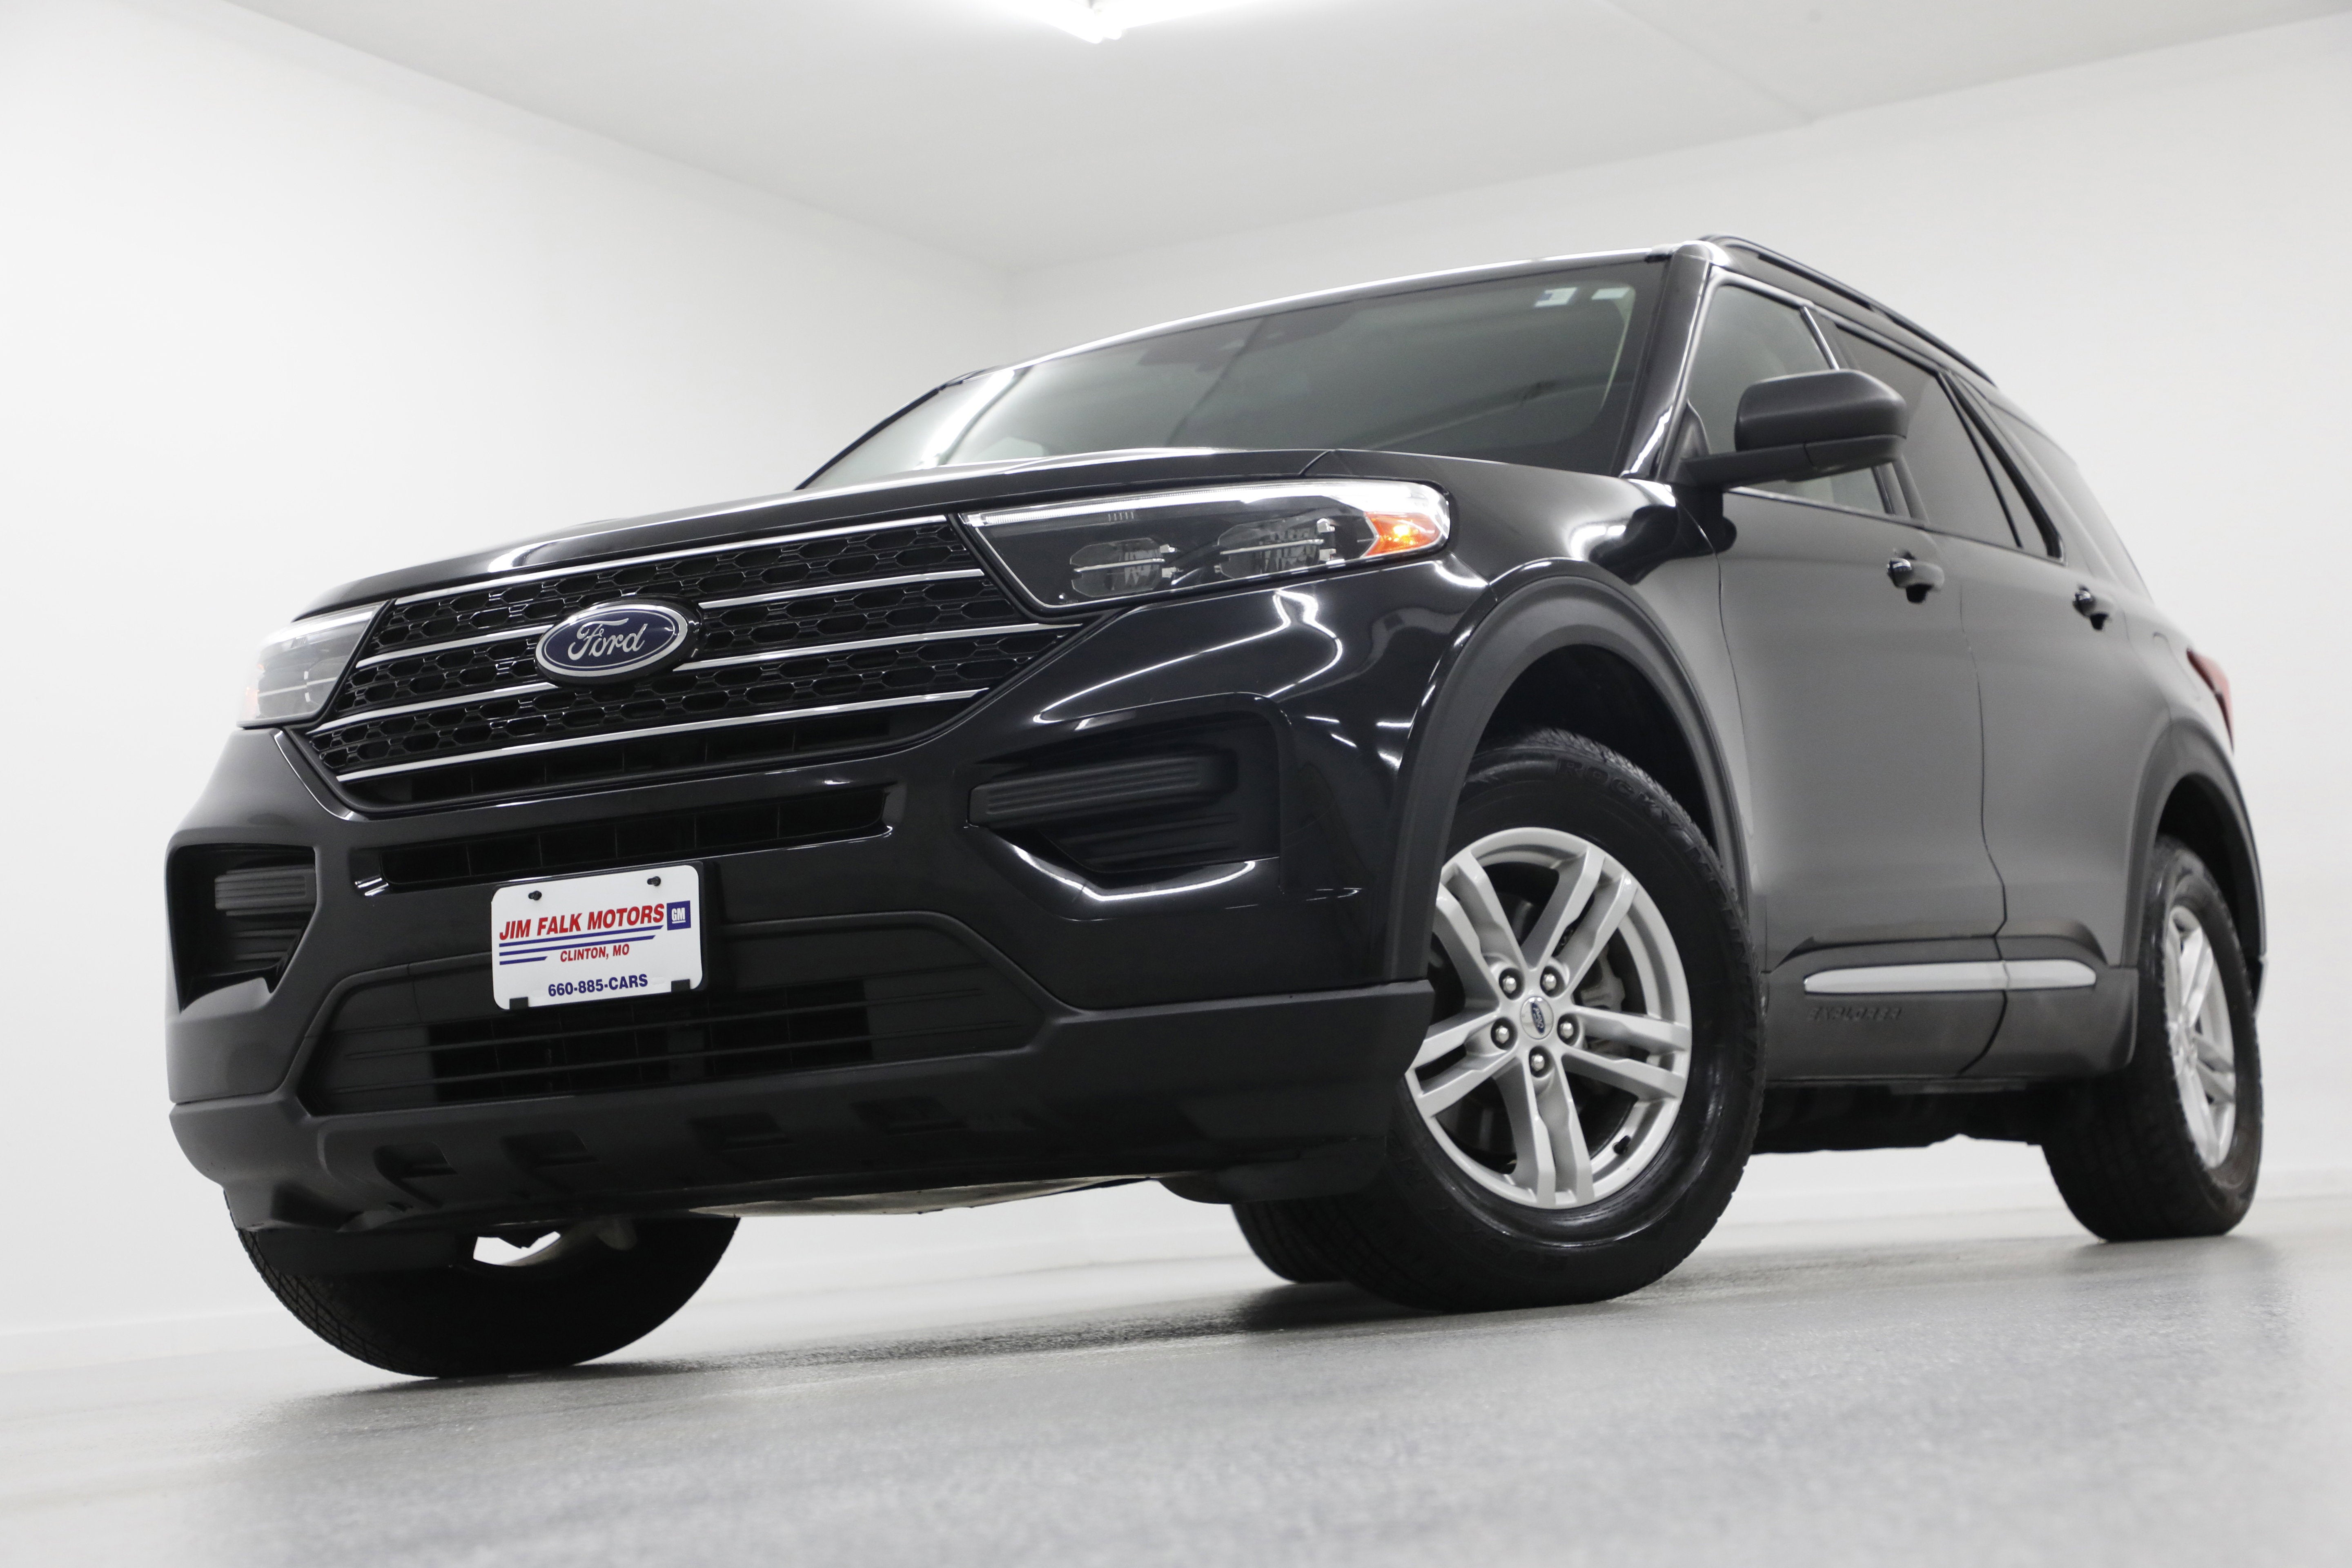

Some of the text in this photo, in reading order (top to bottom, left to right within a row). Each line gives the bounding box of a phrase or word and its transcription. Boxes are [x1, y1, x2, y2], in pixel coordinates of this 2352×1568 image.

[568, 618, 648, 661] Ford
[499, 904, 664, 940] JIM FALK MOTORS
[671, 907, 686, 923] GM
[560, 943, 630, 962] CLINTON, MO
[548, 973, 648, 996] 660-885-CARS
